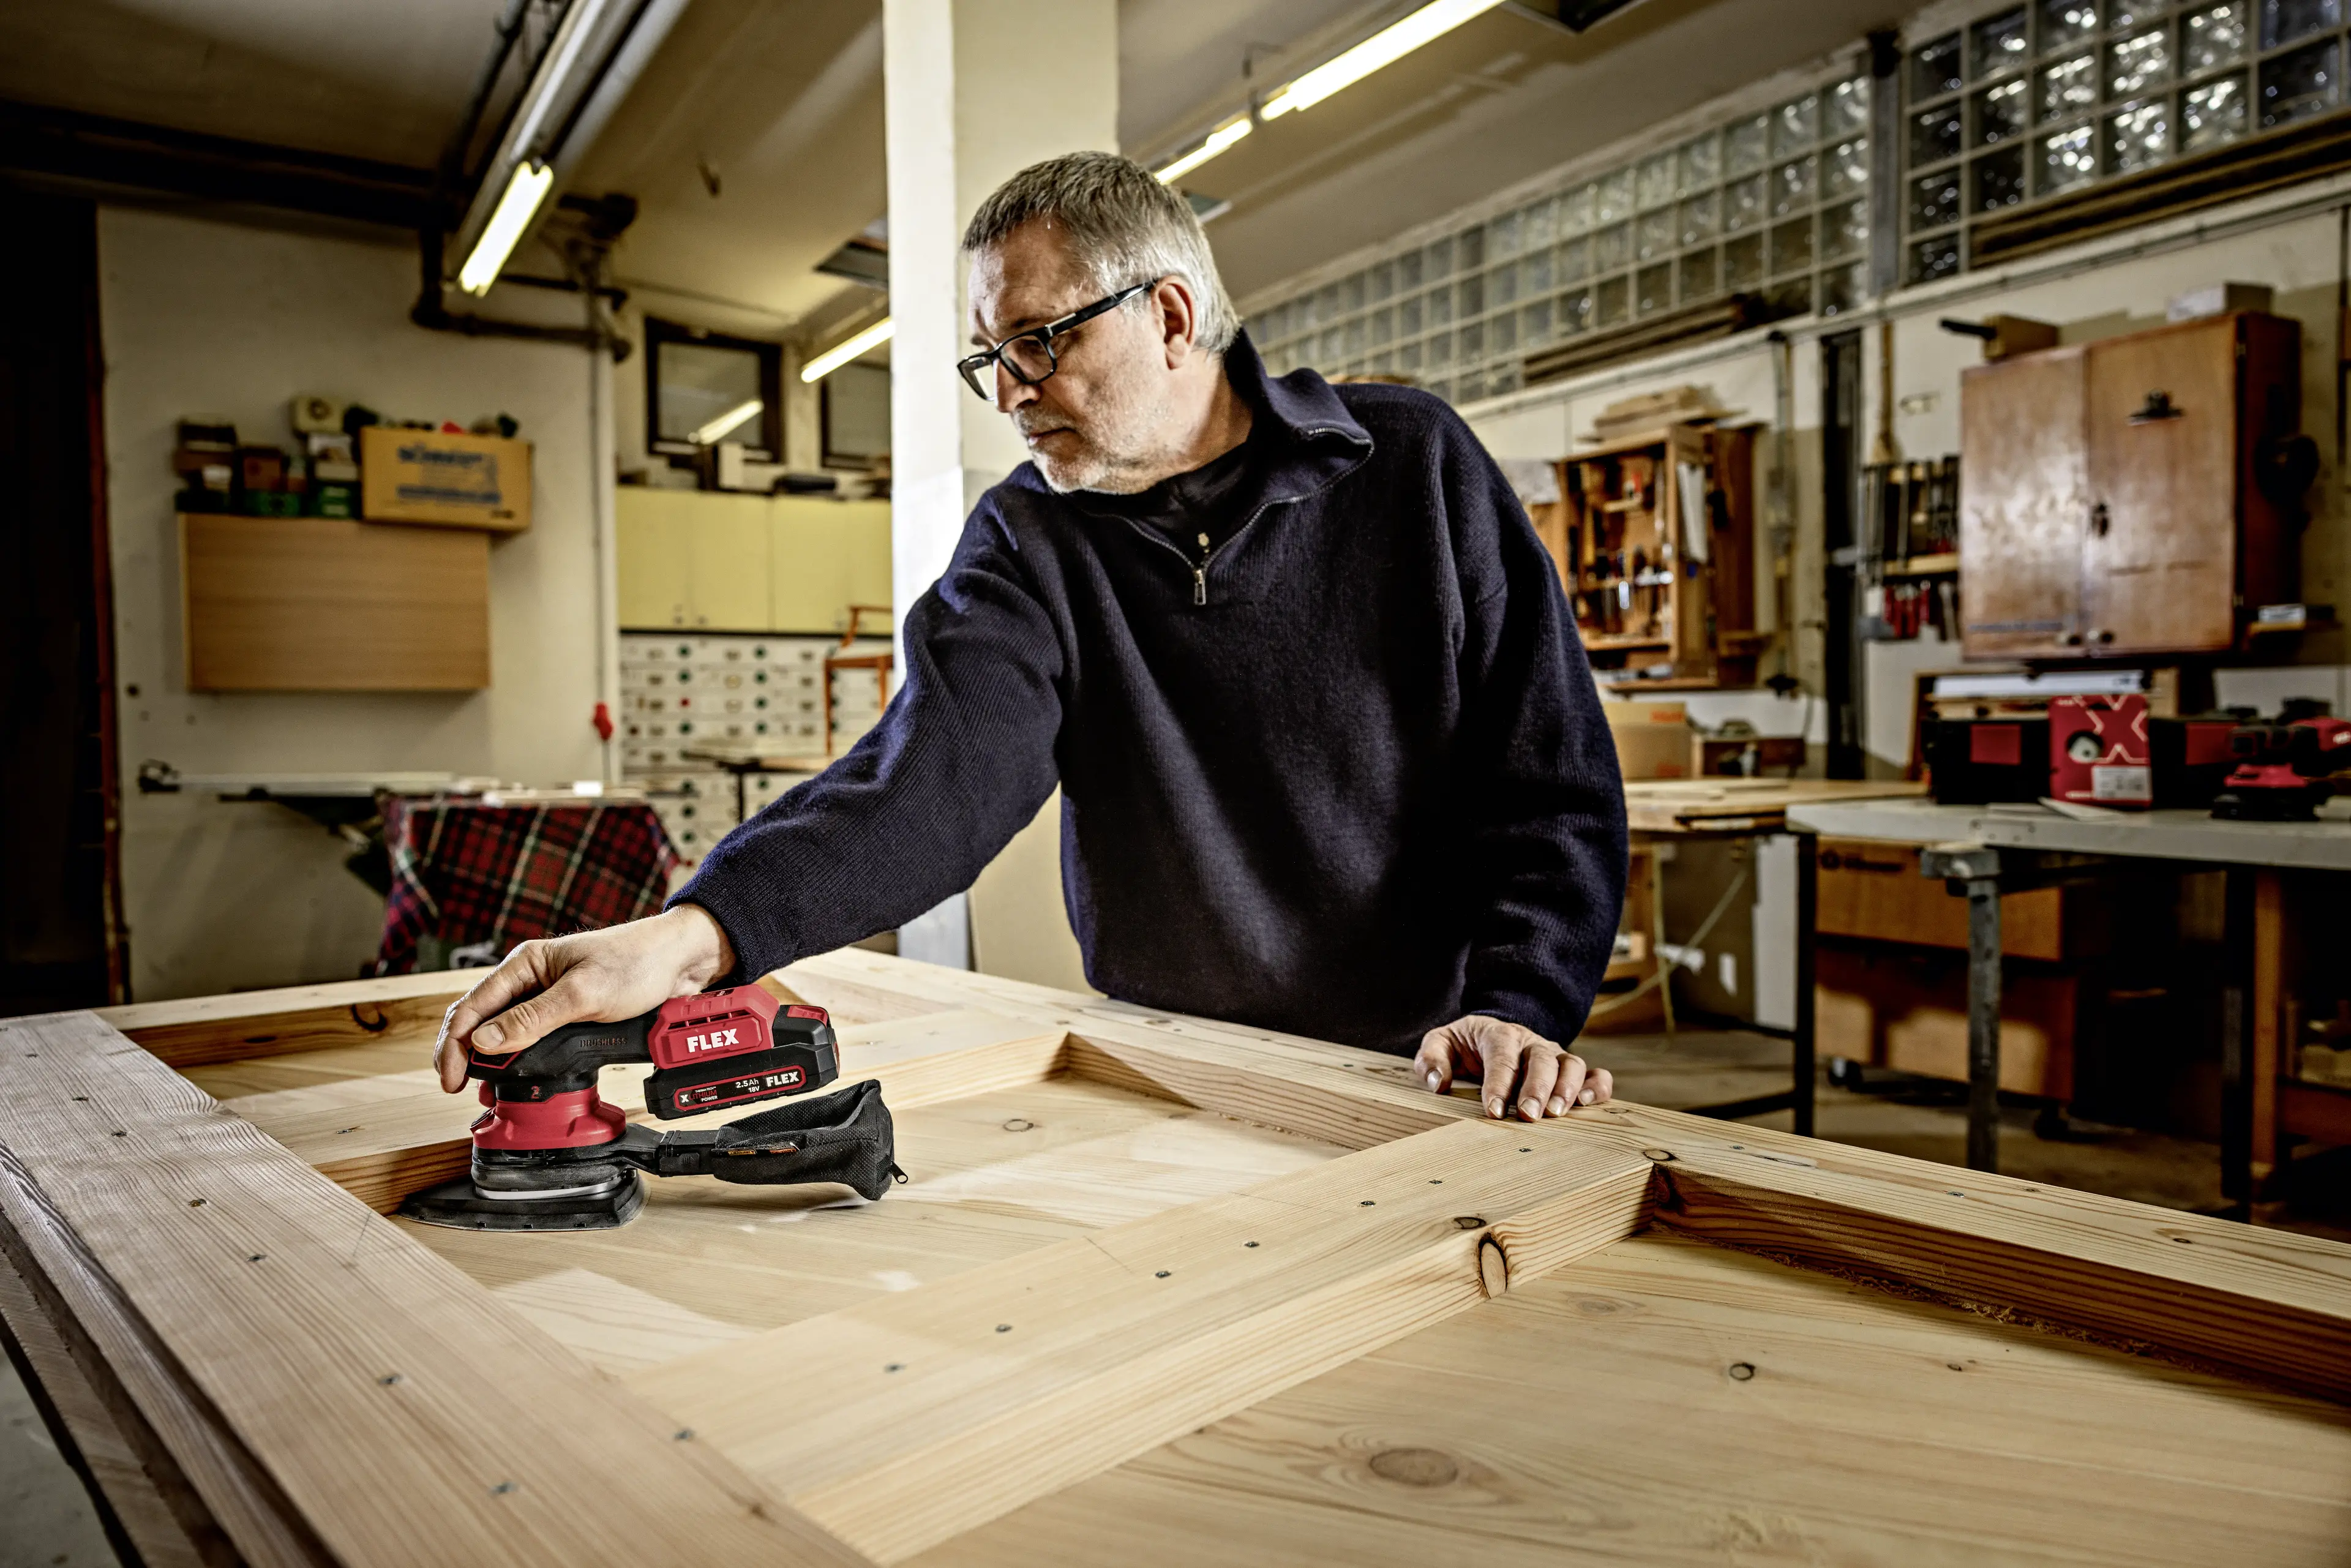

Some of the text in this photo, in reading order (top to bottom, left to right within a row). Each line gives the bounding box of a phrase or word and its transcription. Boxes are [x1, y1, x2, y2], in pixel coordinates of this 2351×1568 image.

[580, 1038, 628, 1048] BRUSHLESS
[686, 1029, 740, 1052] FLEX
[735, 1078, 759, 1089] 2.5Ah
[766, 1071, 800, 1087] FLEX
[531, 1086, 539, 1099] 2
[680, 1089, 718, 1103] X LITHIUM
